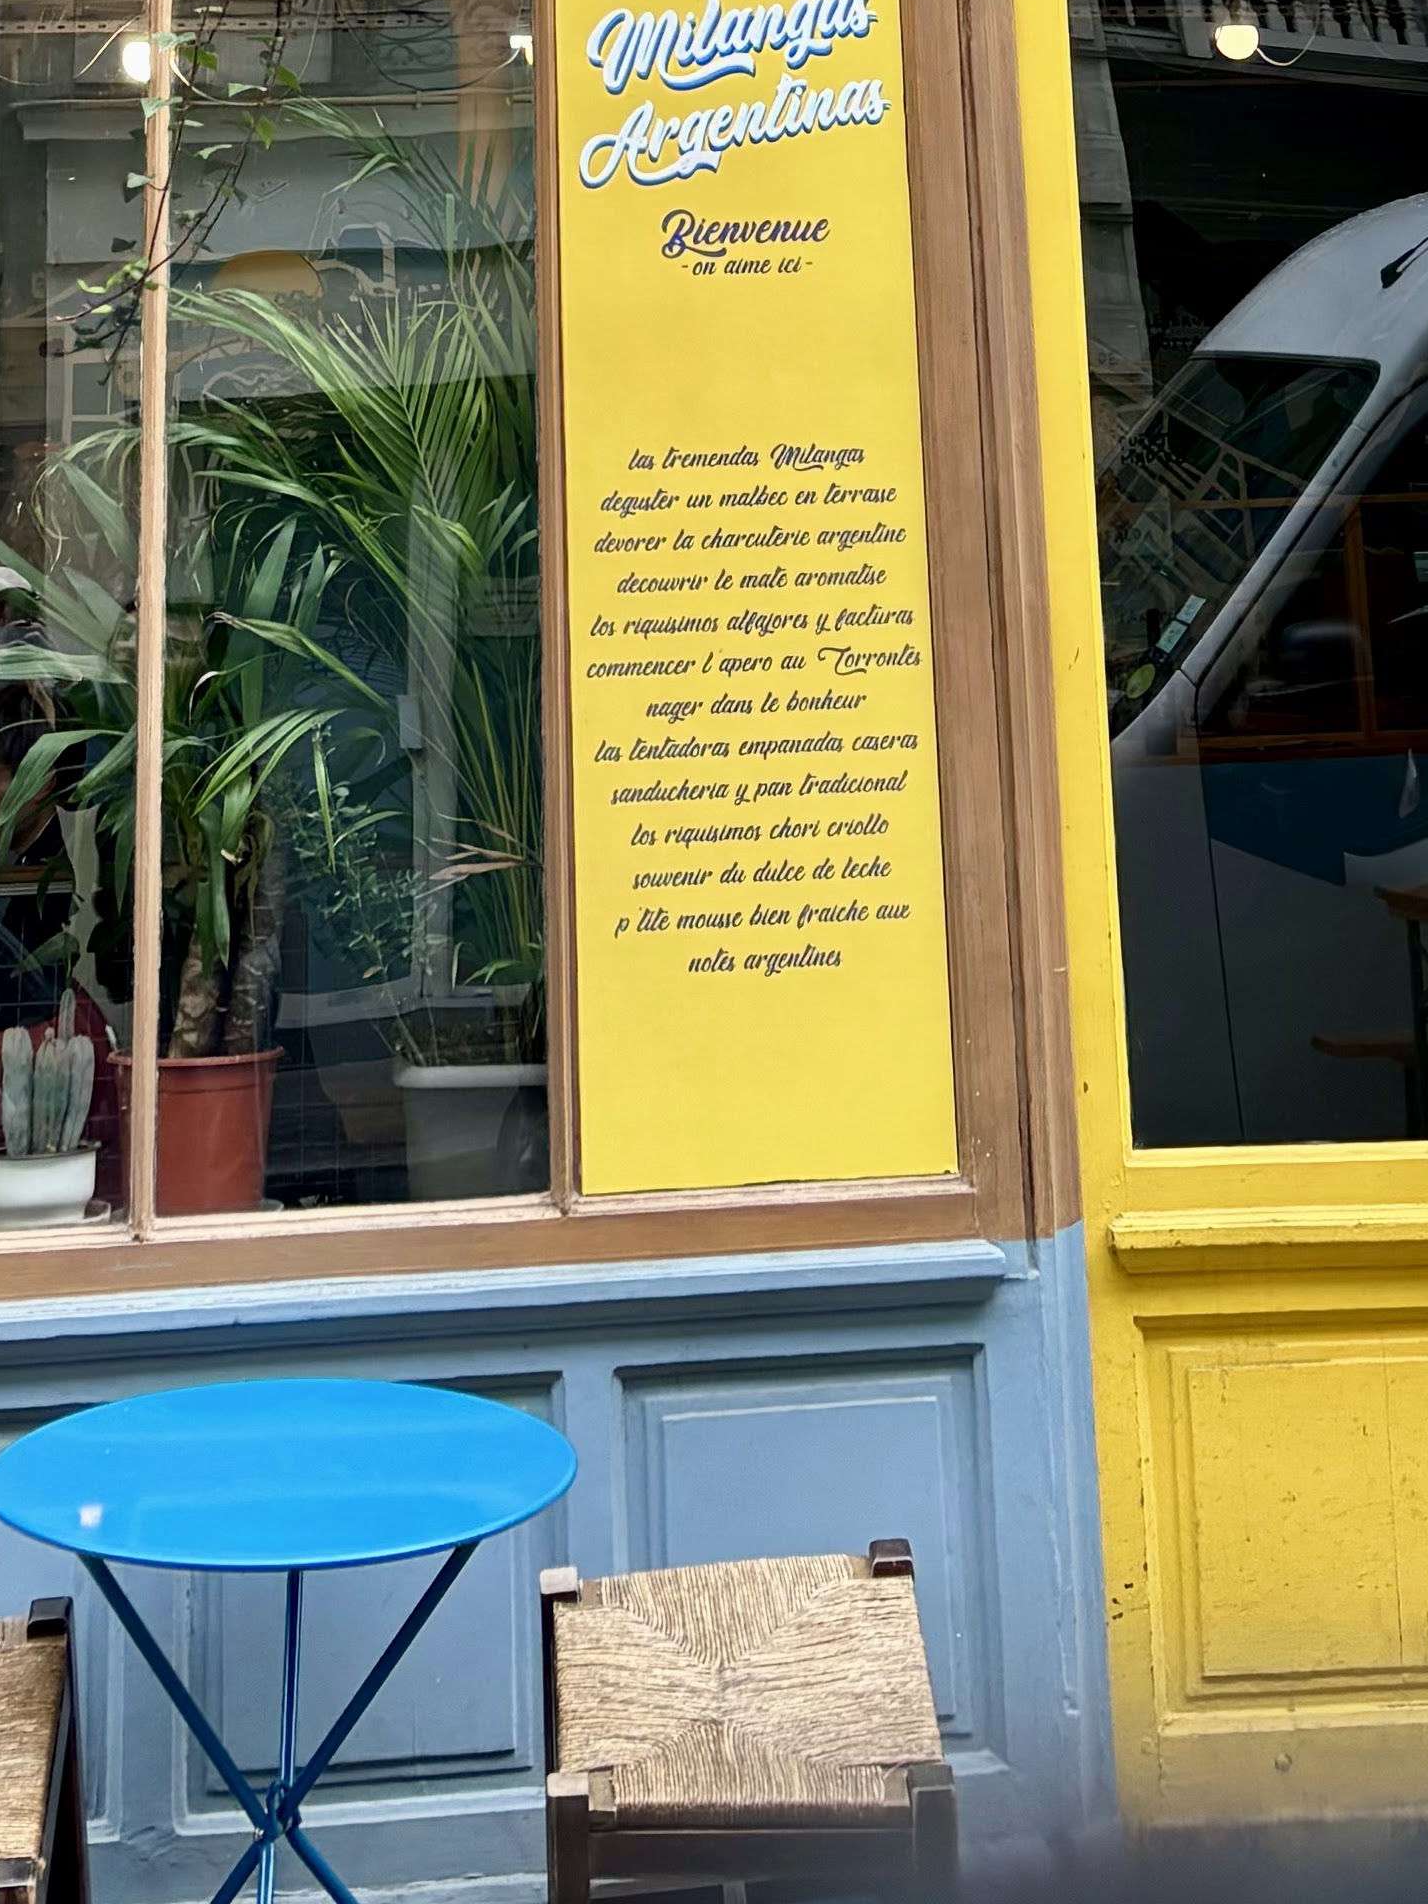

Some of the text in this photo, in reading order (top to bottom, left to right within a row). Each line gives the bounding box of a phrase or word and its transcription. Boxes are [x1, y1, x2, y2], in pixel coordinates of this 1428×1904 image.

[579, 72, 892, 190] Argentinas
[660, 208, 831, 260] Bienvenue
[724, 258, 772, 275] aime
[628, 442, 866, 471] las tremendas Milangas
[599, 482, 897, 518] deguster un malbec en terrasse
[594, 521, 908, 554] devorer la charcuterie argentine
[616, 571, 709, 594] decouvrir
[713, 568, 734, 590] le
[794, 563, 888, 587] aromatise
[590, 603, 915, 640] los riquisimos alfajores y facturas
[586, 658, 697, 679] commencer
[780, 654, 807, 671] au
[645, 688, 868, 725] nager dans le bonheur
[594, 730, 919, 763] las tentadoras empanadas caseras
[610, 770, 909, 806] sanducheria y pan tradicional
[630, 813, 890, 849] los riquisimos chori criollo
[632, 855, 893, 891] souvenir du dulce de leche
[676, 910, 744, 931] mousse
[749, 903, 793, 927] bien
[796, 899, 870, 930] fraiche
[875, 904, 912, 921] aux
[688, 943, 843, 978] notes argentines
